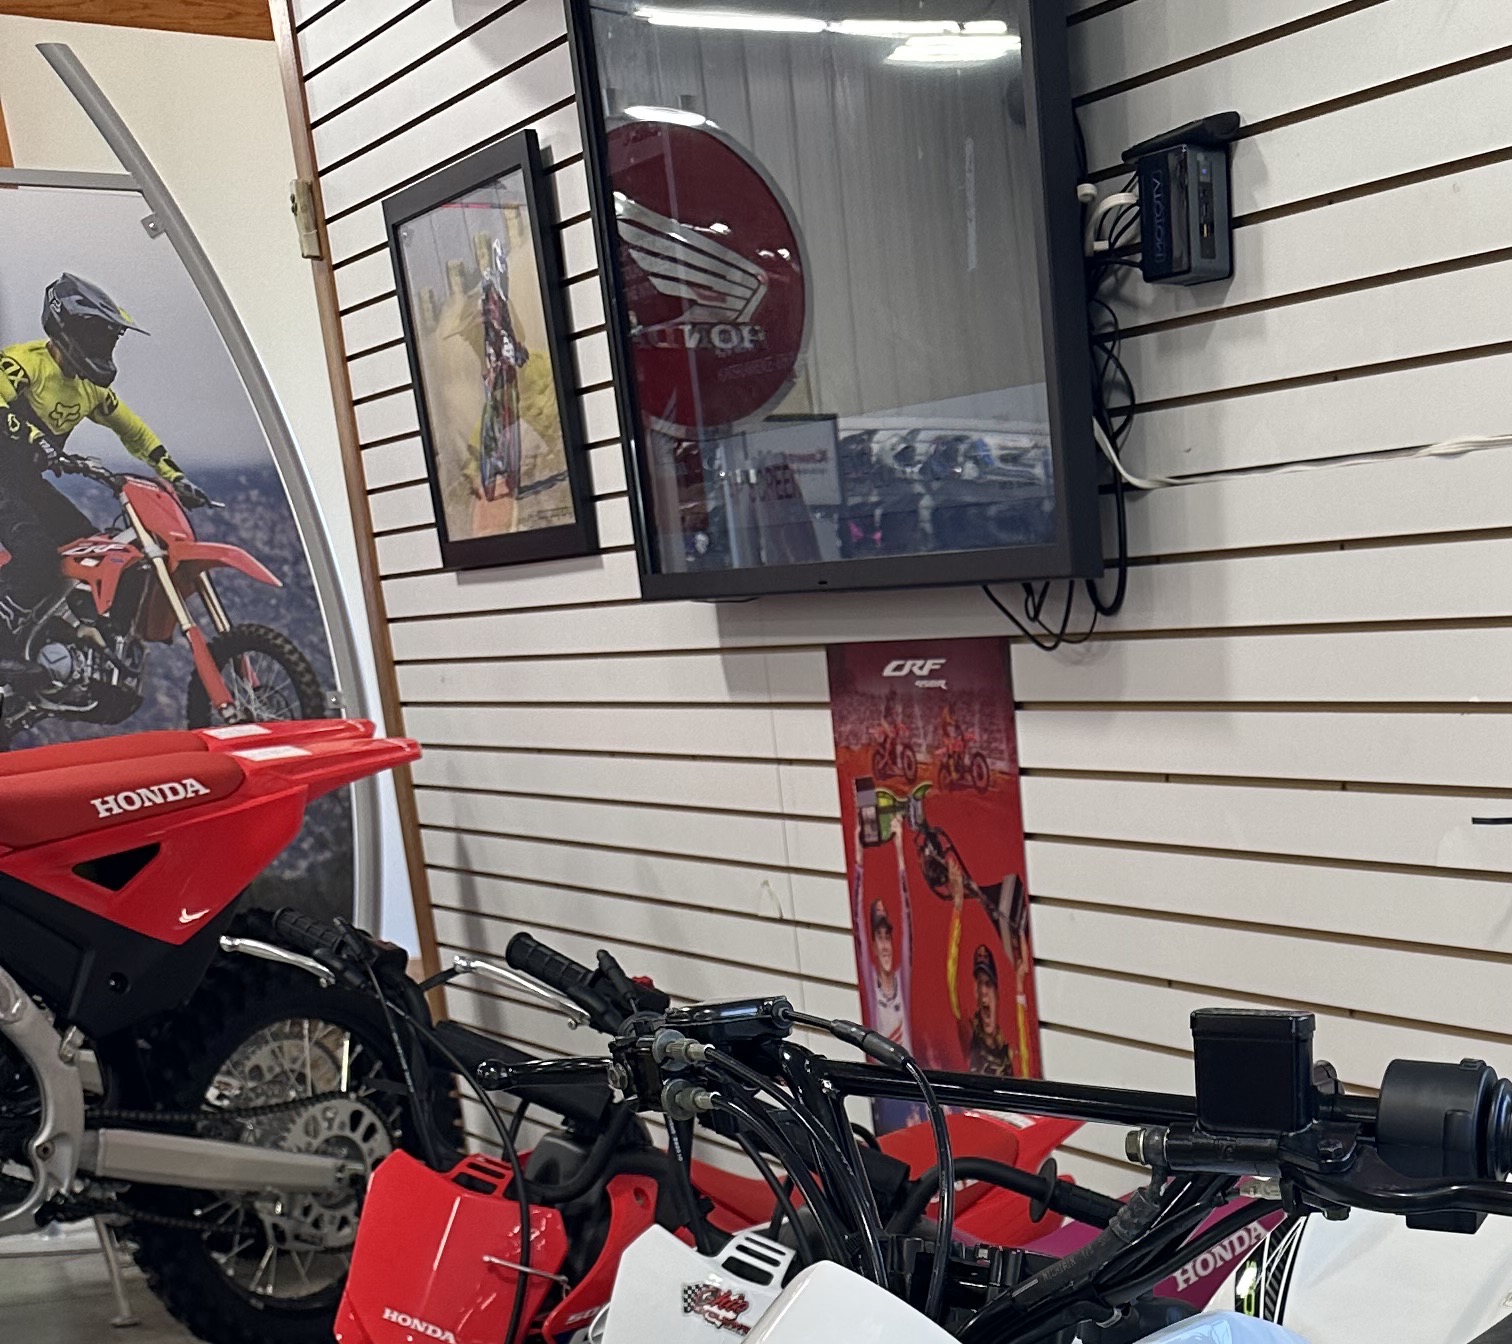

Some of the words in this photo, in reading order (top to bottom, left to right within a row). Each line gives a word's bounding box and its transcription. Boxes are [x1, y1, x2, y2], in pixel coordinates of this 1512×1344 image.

[882, 659, 947, 677] CRF
[90, 777, 211, 818] HONDA
[1173, 1219, 1269, 1293] HONDA
